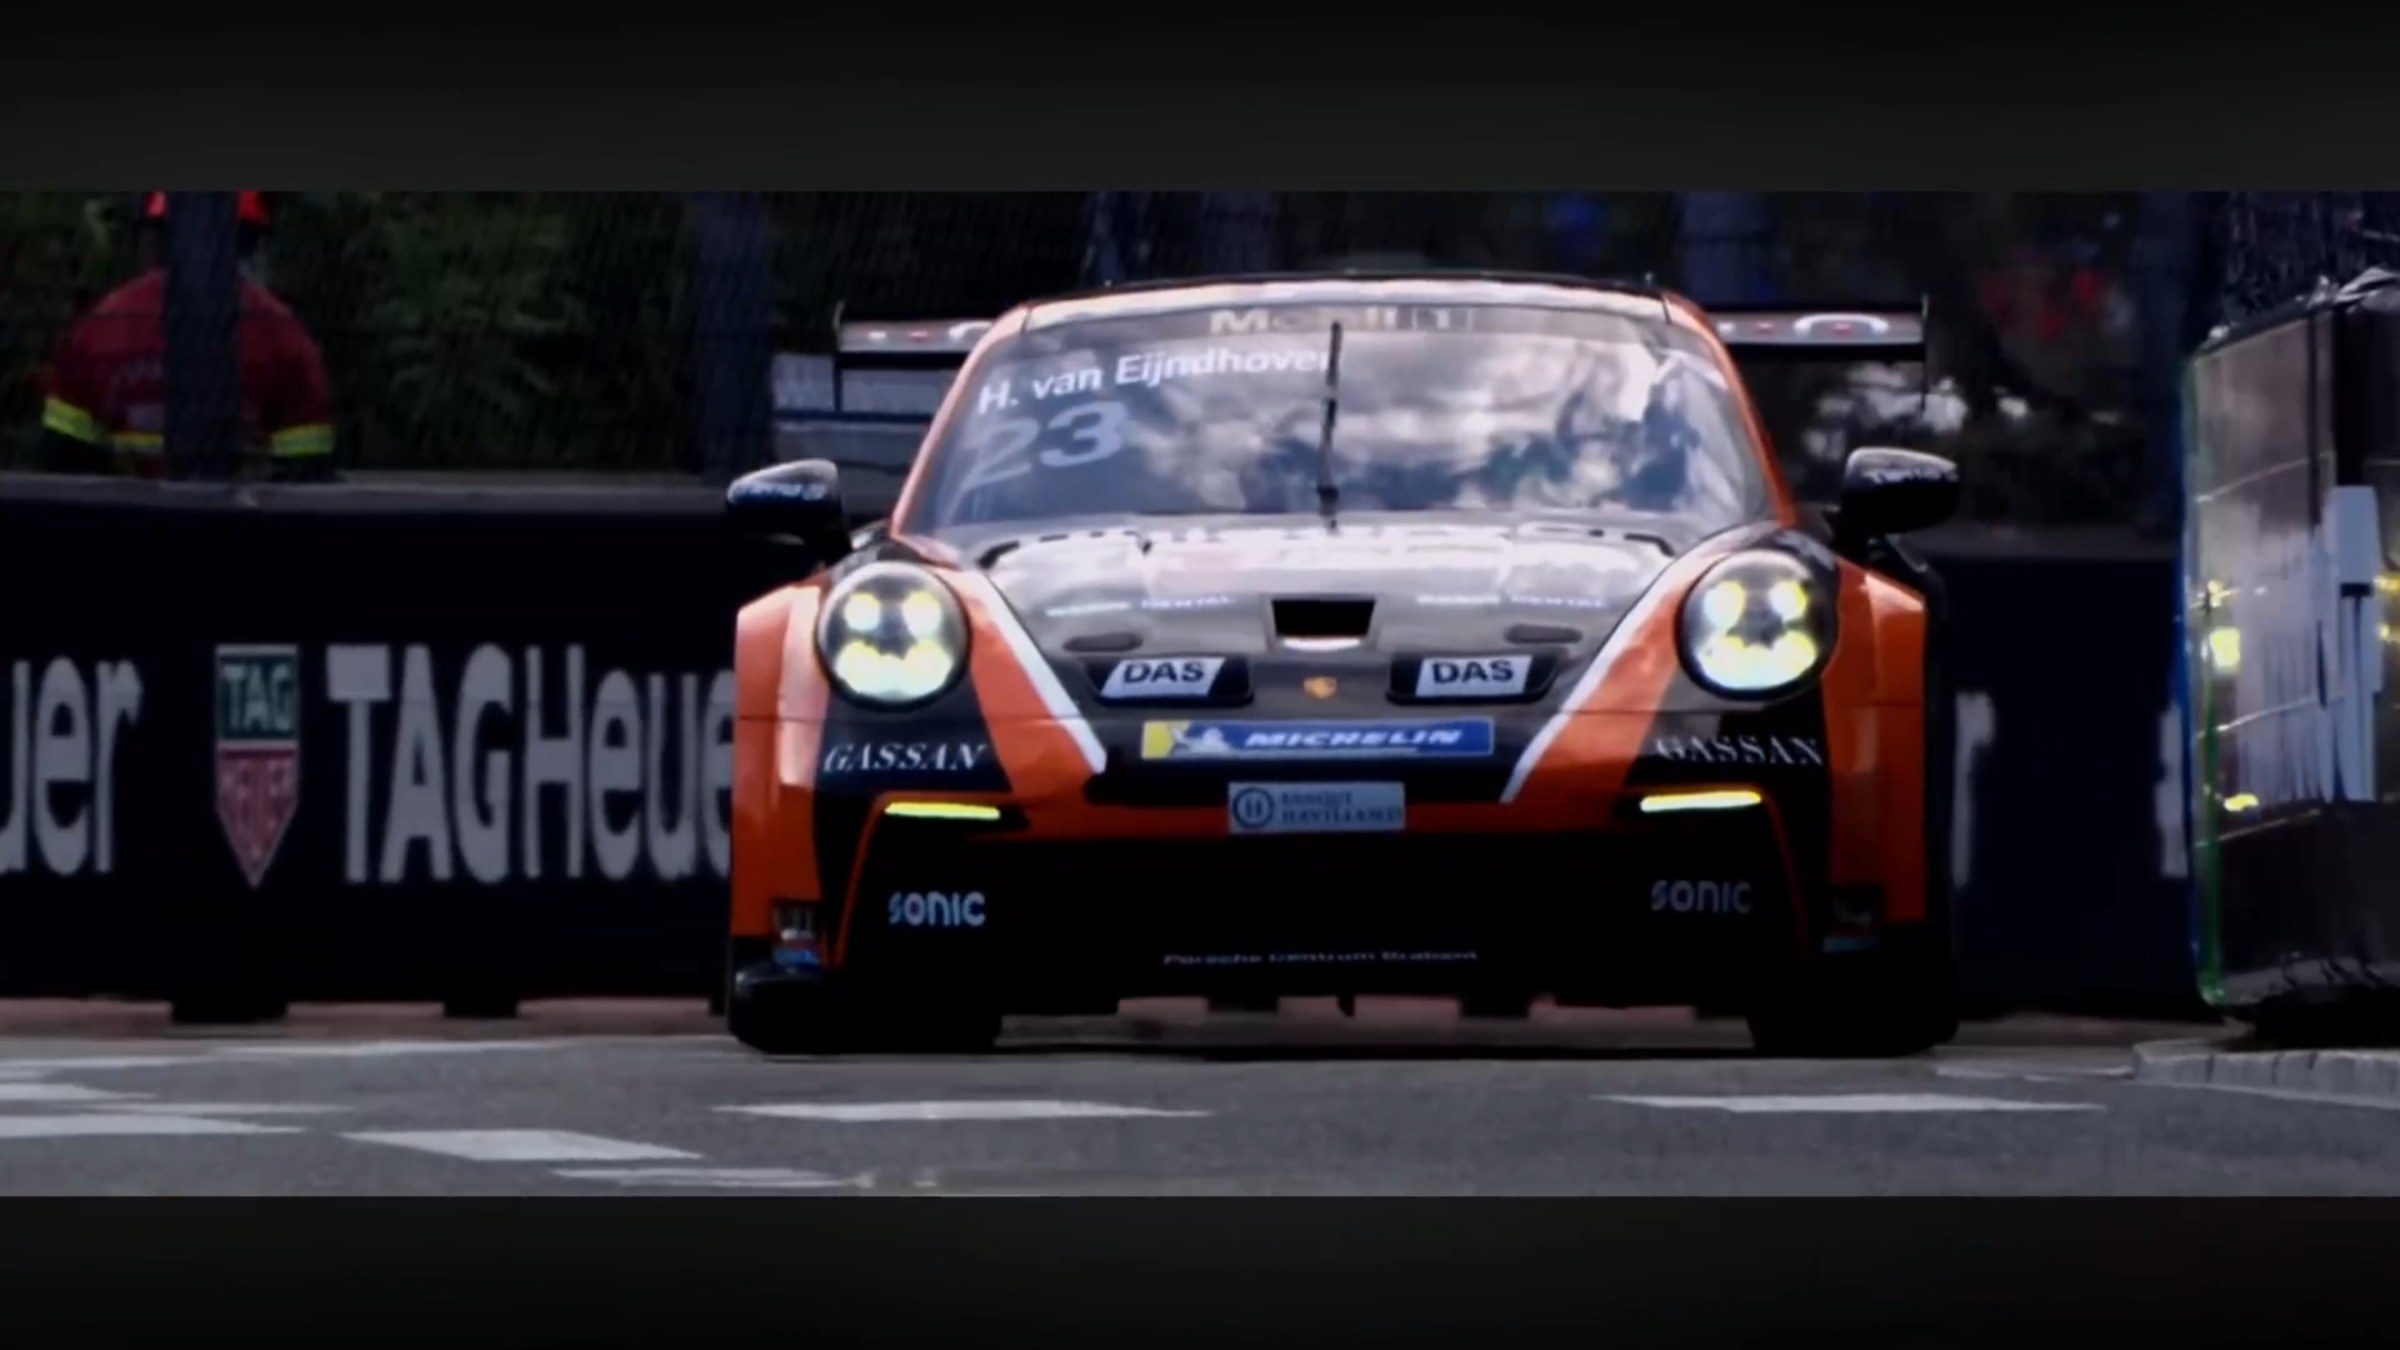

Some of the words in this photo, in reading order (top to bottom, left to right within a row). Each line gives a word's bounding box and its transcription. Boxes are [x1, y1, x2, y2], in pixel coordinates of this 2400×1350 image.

[1210, 306, 1398, 334] Moil
[980, 379, 1019, 413] H.
[1032, 367, 1101, 399] van
[960, 401, 1126, 489] 23
[1123, 661, 1205, 685] DAS
[1431, 659, 1514, 684] DAS
[224, 664, 293, 731] TAG
[1245, 729, 1463, 748] MICHELIN
[1655, 734, 1823, 766] GASSAN
[326, 643, 735, 883] TAGHeue
[824, 742, 986, 773] GASSAN
